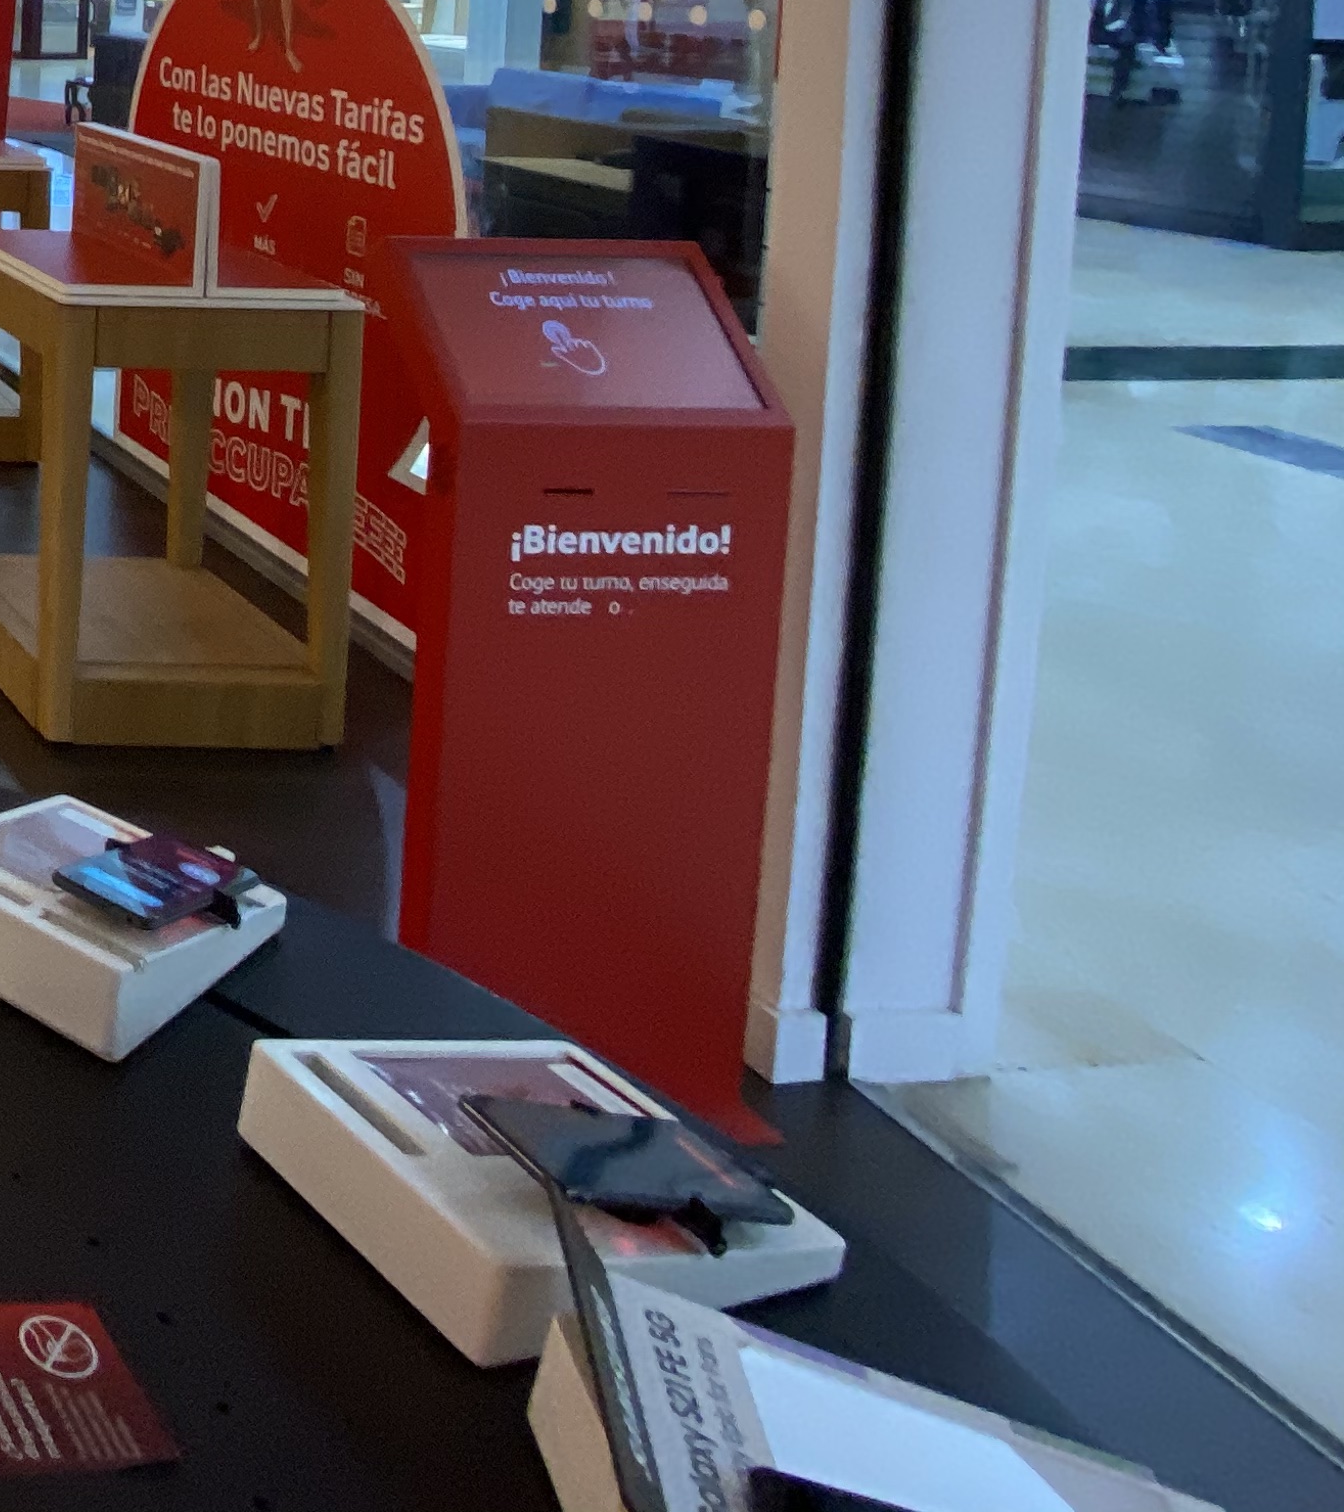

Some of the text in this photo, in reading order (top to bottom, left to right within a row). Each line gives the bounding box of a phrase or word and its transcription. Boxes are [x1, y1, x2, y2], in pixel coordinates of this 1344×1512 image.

[159, 55, 425, 144] Con las Nuevas Tarifas
[173, 102, 192, 134] te
[197, 105, 216, 139] lo
[221, 119, 330, 172] ponemos
[337, 139, 397, 190] fácil
[510, 524, 732, 562] ¡Bienvenido!
[509, 572, 555, 594] Coge
[638, 574, 729, 595] enseguida
[508, 598, 526, 615] te
[644, 1308, 681, 1348] 5G
